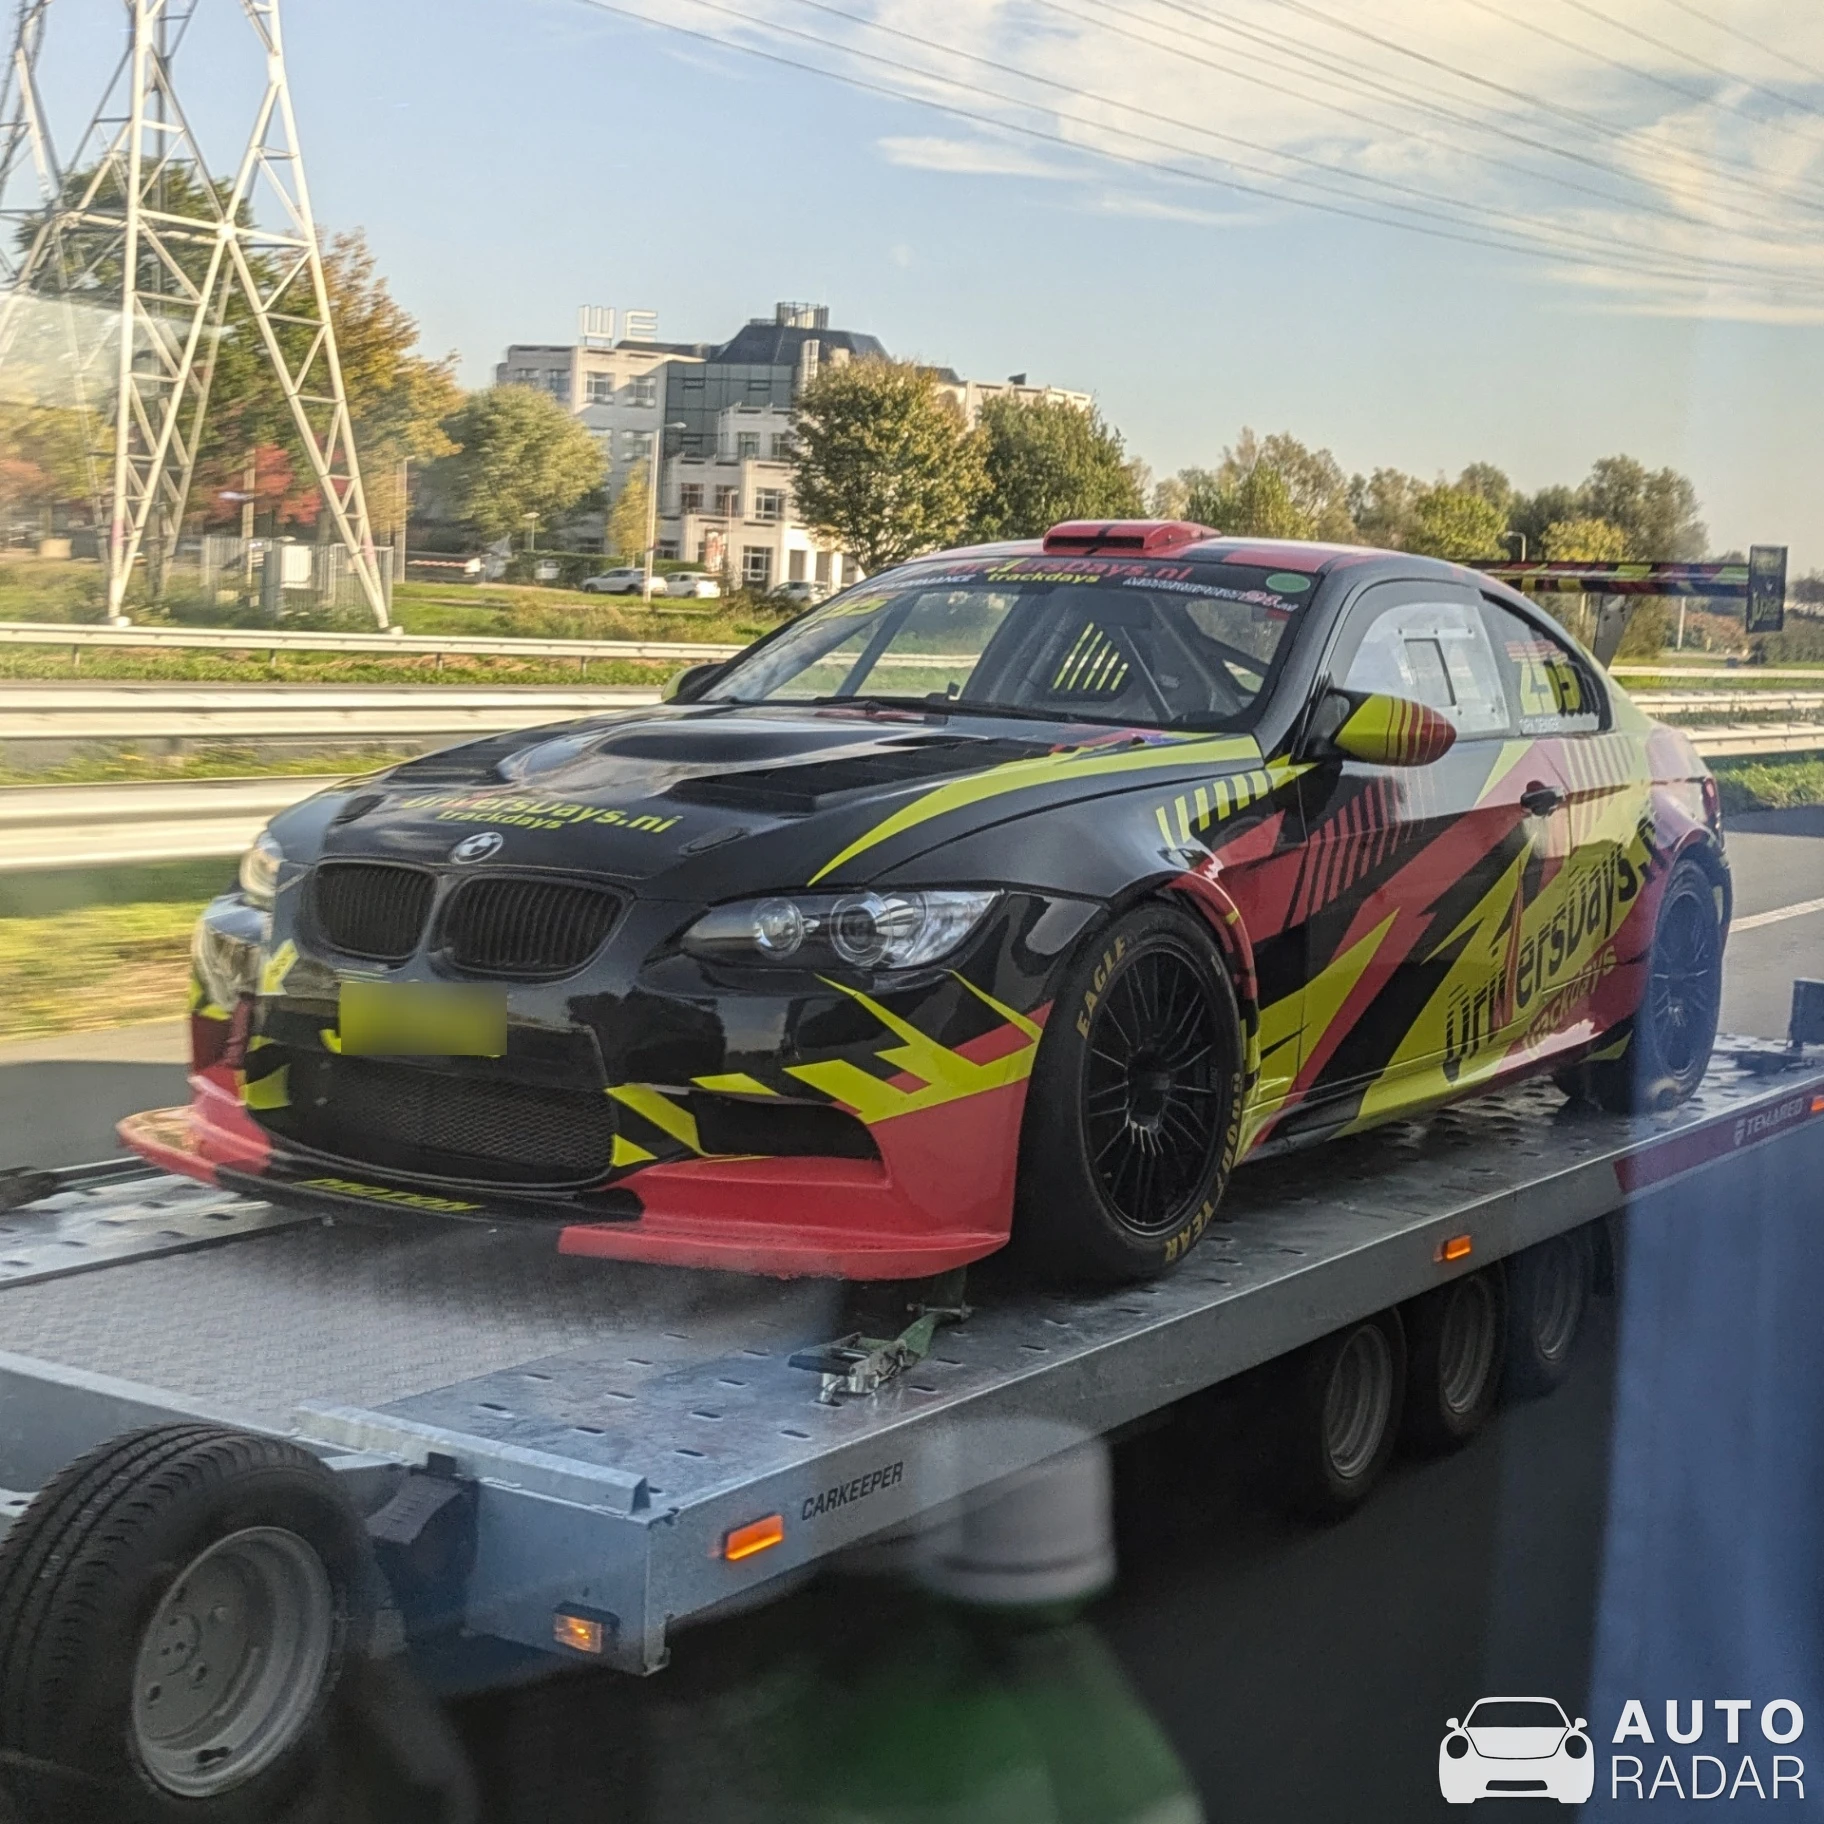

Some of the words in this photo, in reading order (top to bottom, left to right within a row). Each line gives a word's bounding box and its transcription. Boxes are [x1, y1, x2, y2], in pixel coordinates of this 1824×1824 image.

[579, 304, 658, 341] WE
[985, 571, 1101, 584] trackdays
[435, 809, 566, 830] trackdays
[1076, 935, 1127, 1040] EAGLE
[802, 1461, 904, 1521] CARKEEPER
